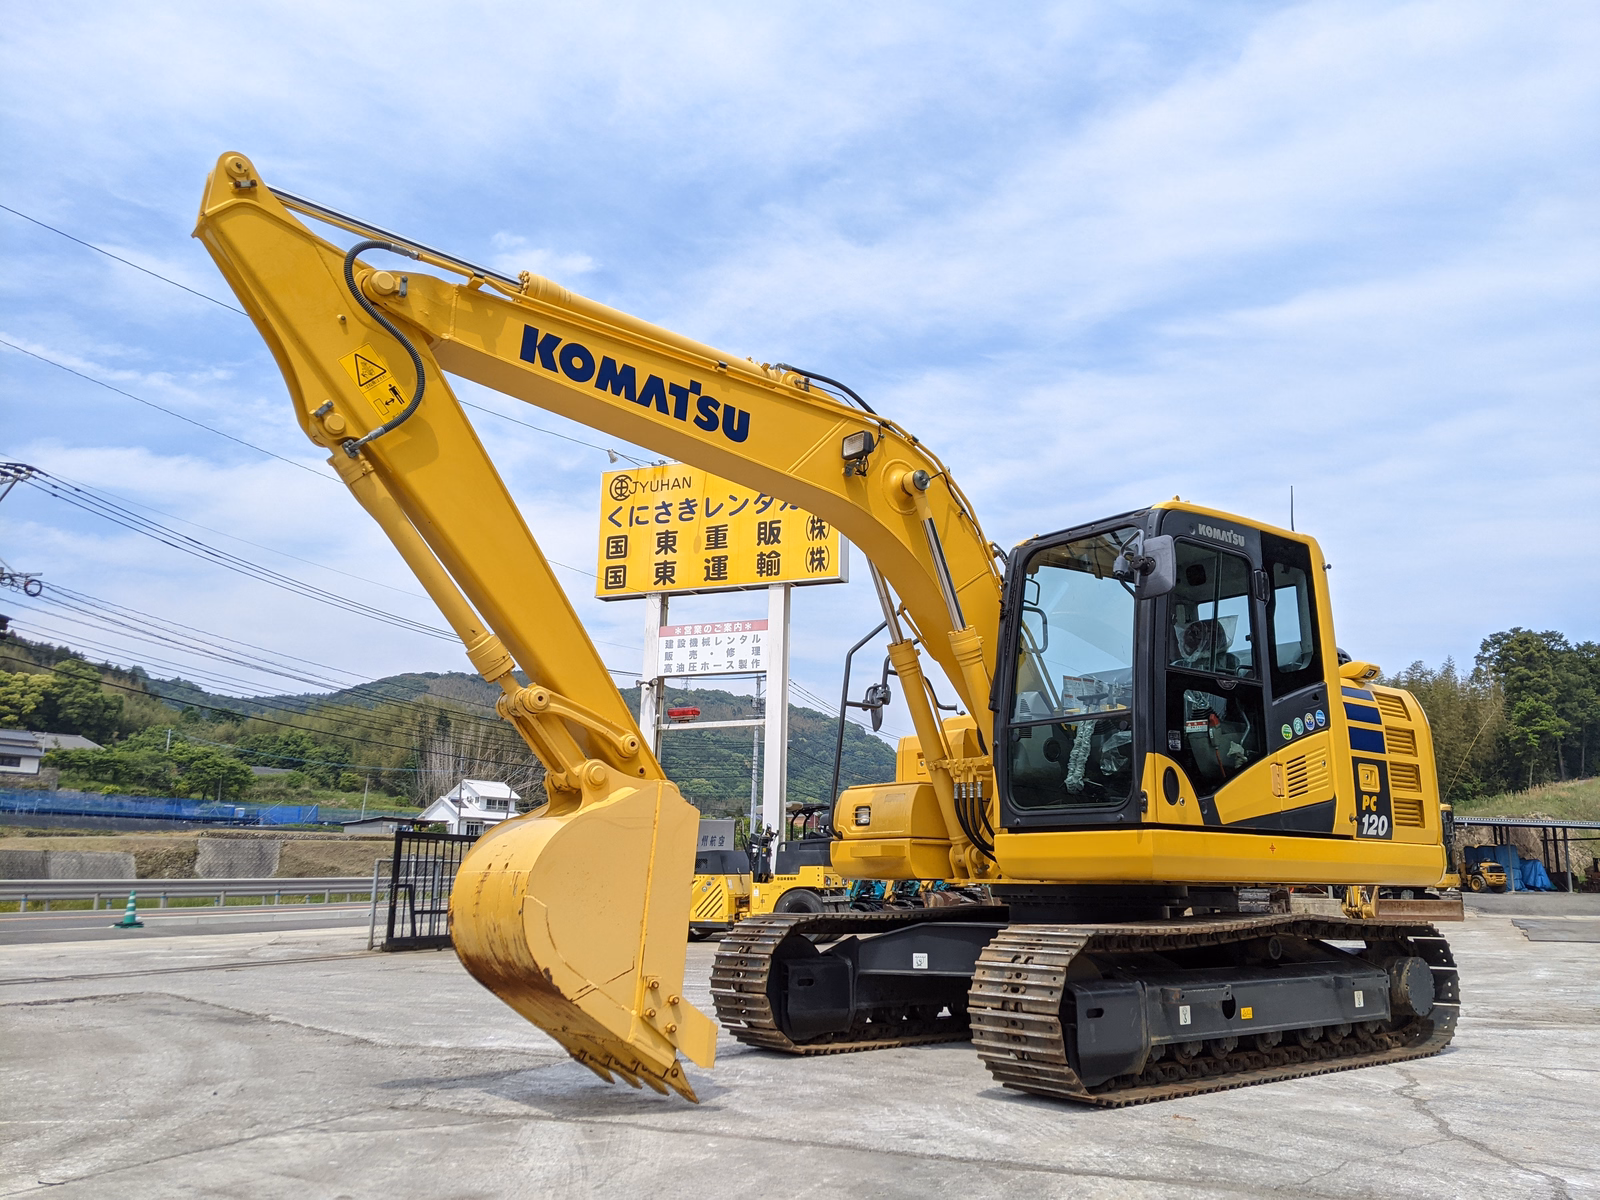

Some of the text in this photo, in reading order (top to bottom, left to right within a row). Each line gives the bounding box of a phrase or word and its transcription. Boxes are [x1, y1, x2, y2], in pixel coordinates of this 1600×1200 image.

[520, 324, 751, 443] KOMATSU
[628, 476, 692, 495] JYUHAN
[1198, 523, 1245, 547] KOMATSU
[664, 634, 762, 650] 建設機械レンタル
[663, 658, 761, 674] 高油圧ホース製作
[1362, 794, 1378, 812] PC
[1362, 813, 1389, 837] 120
[699, 834, 726, 847] 州航空
